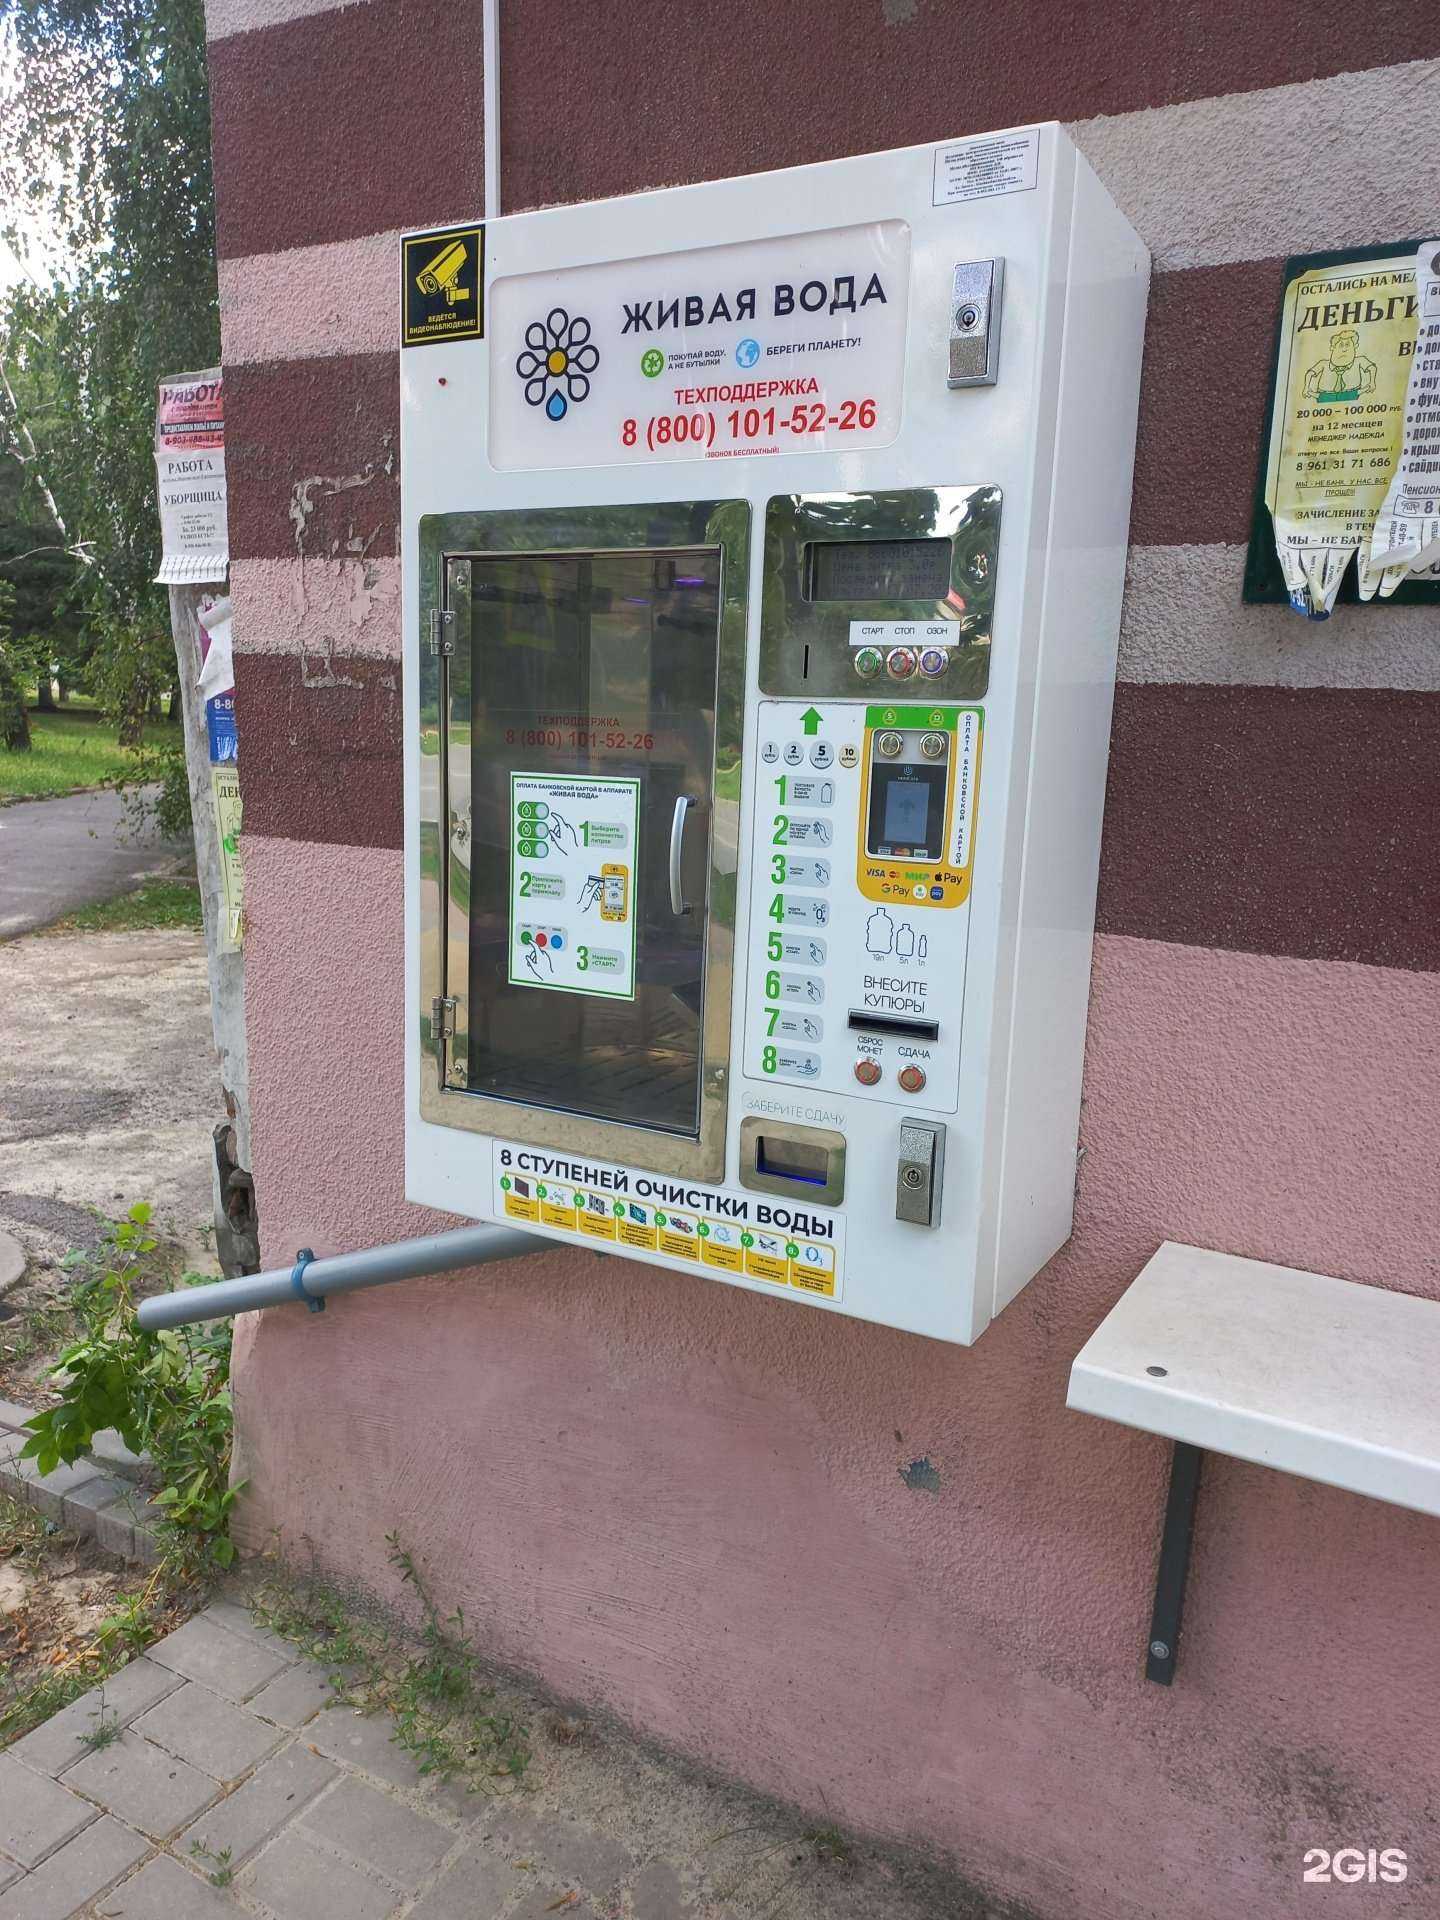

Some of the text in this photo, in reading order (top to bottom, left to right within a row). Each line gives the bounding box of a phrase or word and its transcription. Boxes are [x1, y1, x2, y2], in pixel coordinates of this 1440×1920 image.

[1301, 280, 1367, 296] ОСТАЛИСЬ
[1370, 277, 1388, 287] НА
[621, 273, 887, 334] ЖИВАЯ ВОДА
[766, 338, 862, 356] БЕРЕГИ ПЛАНЕТУ!
[668, 350, 703, 362] ПОКУПАЙ
[674, 362, 684, 370] НЕ
[686, 358, 720, 368] БУТЫЛКИ
[674, 377, 819, 406] ТЕХПОДДЕРЖКА
[1296, 410, 1310, 418] 20
[1312, 408, 1332, 418] 000
[1344, 406, 1364, 416] 100
[1366, 404, 1387, 414] 000
[622, 399, 876, 452] 8 (800) 101-52-26
[1312, 420, 1383, 432] на 12 месяцев
[1308, 432, 1385, 443] МЕНЕДЖЕР НАДЕЖДА
[168, 459, 214, 474] РАБОТА
[1296, 458, 1391, 471] 8 961 31 71 686
[164, 490, 222, 505] УБОРЩИЦА
[1297, 509, 1366, 520] ЗАЧИСЛЕНИЕ
[1346, 522, 1353, 531] В
[1287, 535, 1308, 544] МЫ
[1321, 536, 1337, 544] НЕ
[538, 715, 620, 728] ТЕХПОДДЕРЖКА
[506, 728, 654, 750] 8 (800) 101-52-26
[791, 746, 797, 754] 2
[818, 746, 826, 756] 5
[845, 748, 854, 756] 10
[538, 784, 574, 792] БАНКОВСКОЙ
[603, 787, 632, 795] АППАРАТЕ
[550, 790, 599, 800] «ЖИВАЯ ВОДА»
[774, 774, 786, 806] 1
[956, 714, 972, 865] ОПЛАТА БАНКОВСКОЙ КАРТОЙ
[579, 820, 589, 847] 1
[772, 814, 788, 846] 2
[771, 854, 786, 884] 3
[866, 868, 886, 878] VISA
[520, 872, 532, 898] 2
[944, 872, 963, 885] Pay
[892, 884, 910, 897] Pay
[769, 894, 784, 924] 4
[768, 932, 782, 962] 5
[576, 946, 588, 971] 3
[900, 957, 908, 965] 5л
[766, 970, 780, 999] 6
[864, 976, 928, 996] ВНЕСИТЕ
[864, 993, 925, 1014] КУПЮРЫ
[764, 1008, 780, 1037] 7
[858, 1036, 883, 1046] СБРОС
[857, 1044, 884, 1056] МОНЕТ
[898, 1046, 930, 1060] СДАЧА
[762, 1046, 776, 1074] 8
[746, 1098, 845, 1126] ЗАБЕРИТЕ СДАЧУ
[500, 1150, 834, 1239] 8 СТУПЕНЕЙ ОЧИСТКИ ВОДЫ
